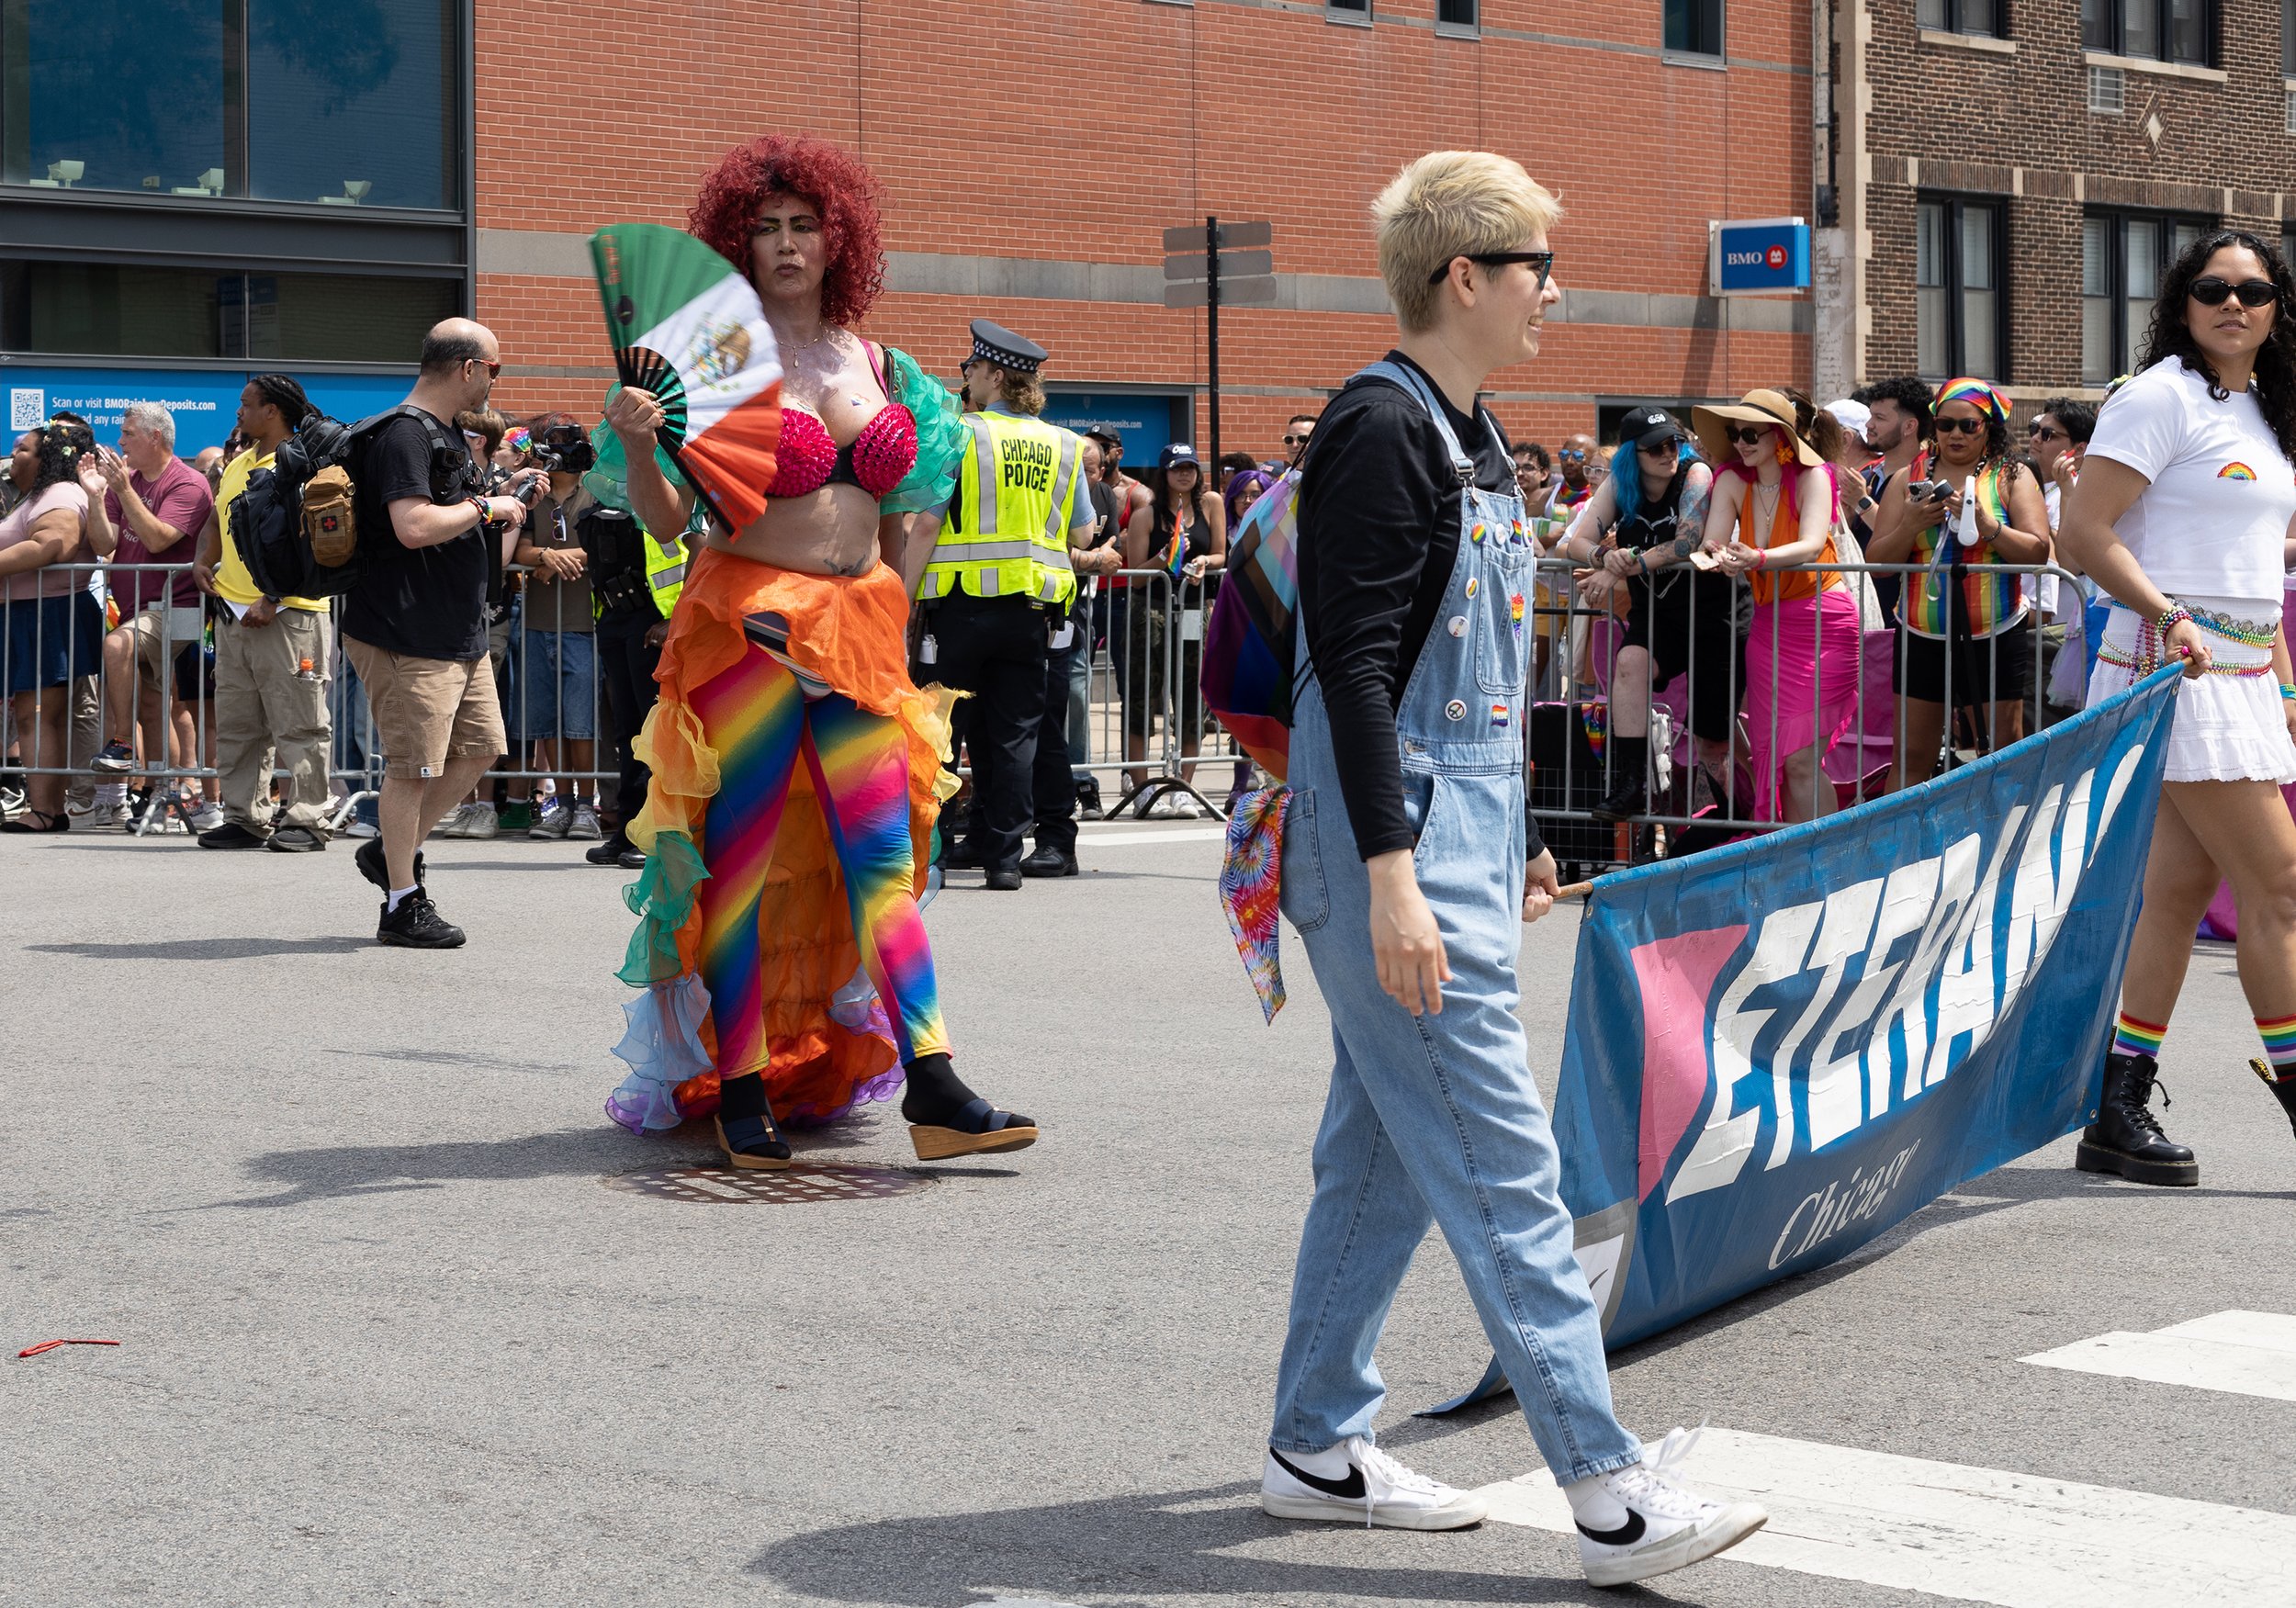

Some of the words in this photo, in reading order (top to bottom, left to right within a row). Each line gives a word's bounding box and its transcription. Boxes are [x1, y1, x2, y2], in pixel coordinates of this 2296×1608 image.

[1727, 251, 1763, 265] BMO
[51, 397, 72, 408] Scan
[74, 399, 84, 409] or
[85, 398, 102, 409] visit
[94, 415, 109, 427] any
[1001, 439, 1052, 467] CHICAGO
[1004, 463, 1050, 493] POICE
